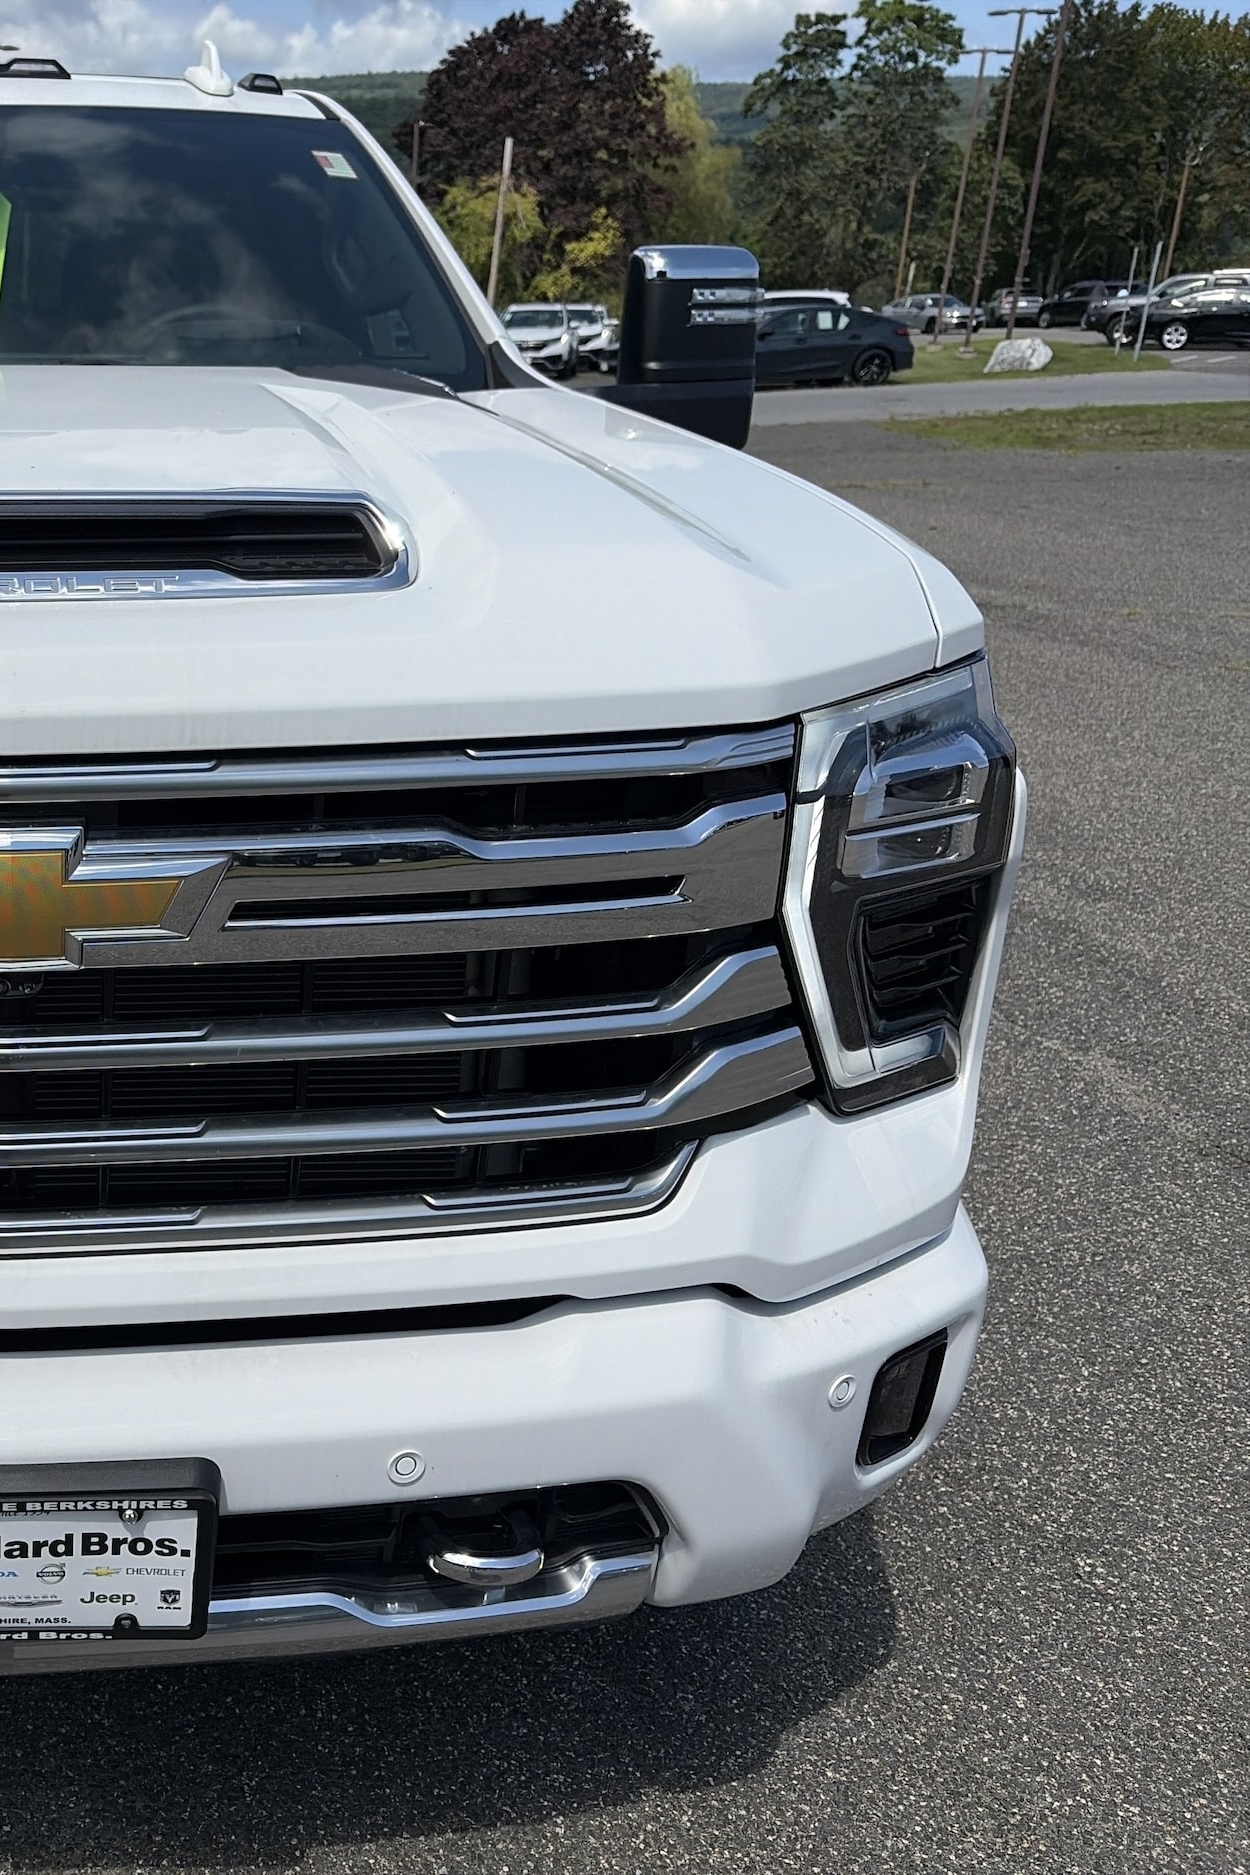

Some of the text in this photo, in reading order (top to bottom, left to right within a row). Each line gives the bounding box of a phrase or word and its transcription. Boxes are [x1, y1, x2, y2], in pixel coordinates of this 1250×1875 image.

[25, 1500, 188, 1511] BERKSHIRES
[81, 1532, 191, 1558] Bros.
[126, 1567, 187, 1577] CHEVROLET
[80, 1591, 136, 1606] Jeep
[34, 1617, 72, 1625] MASS.
[39, 1631, 113, 1640] Bros.
